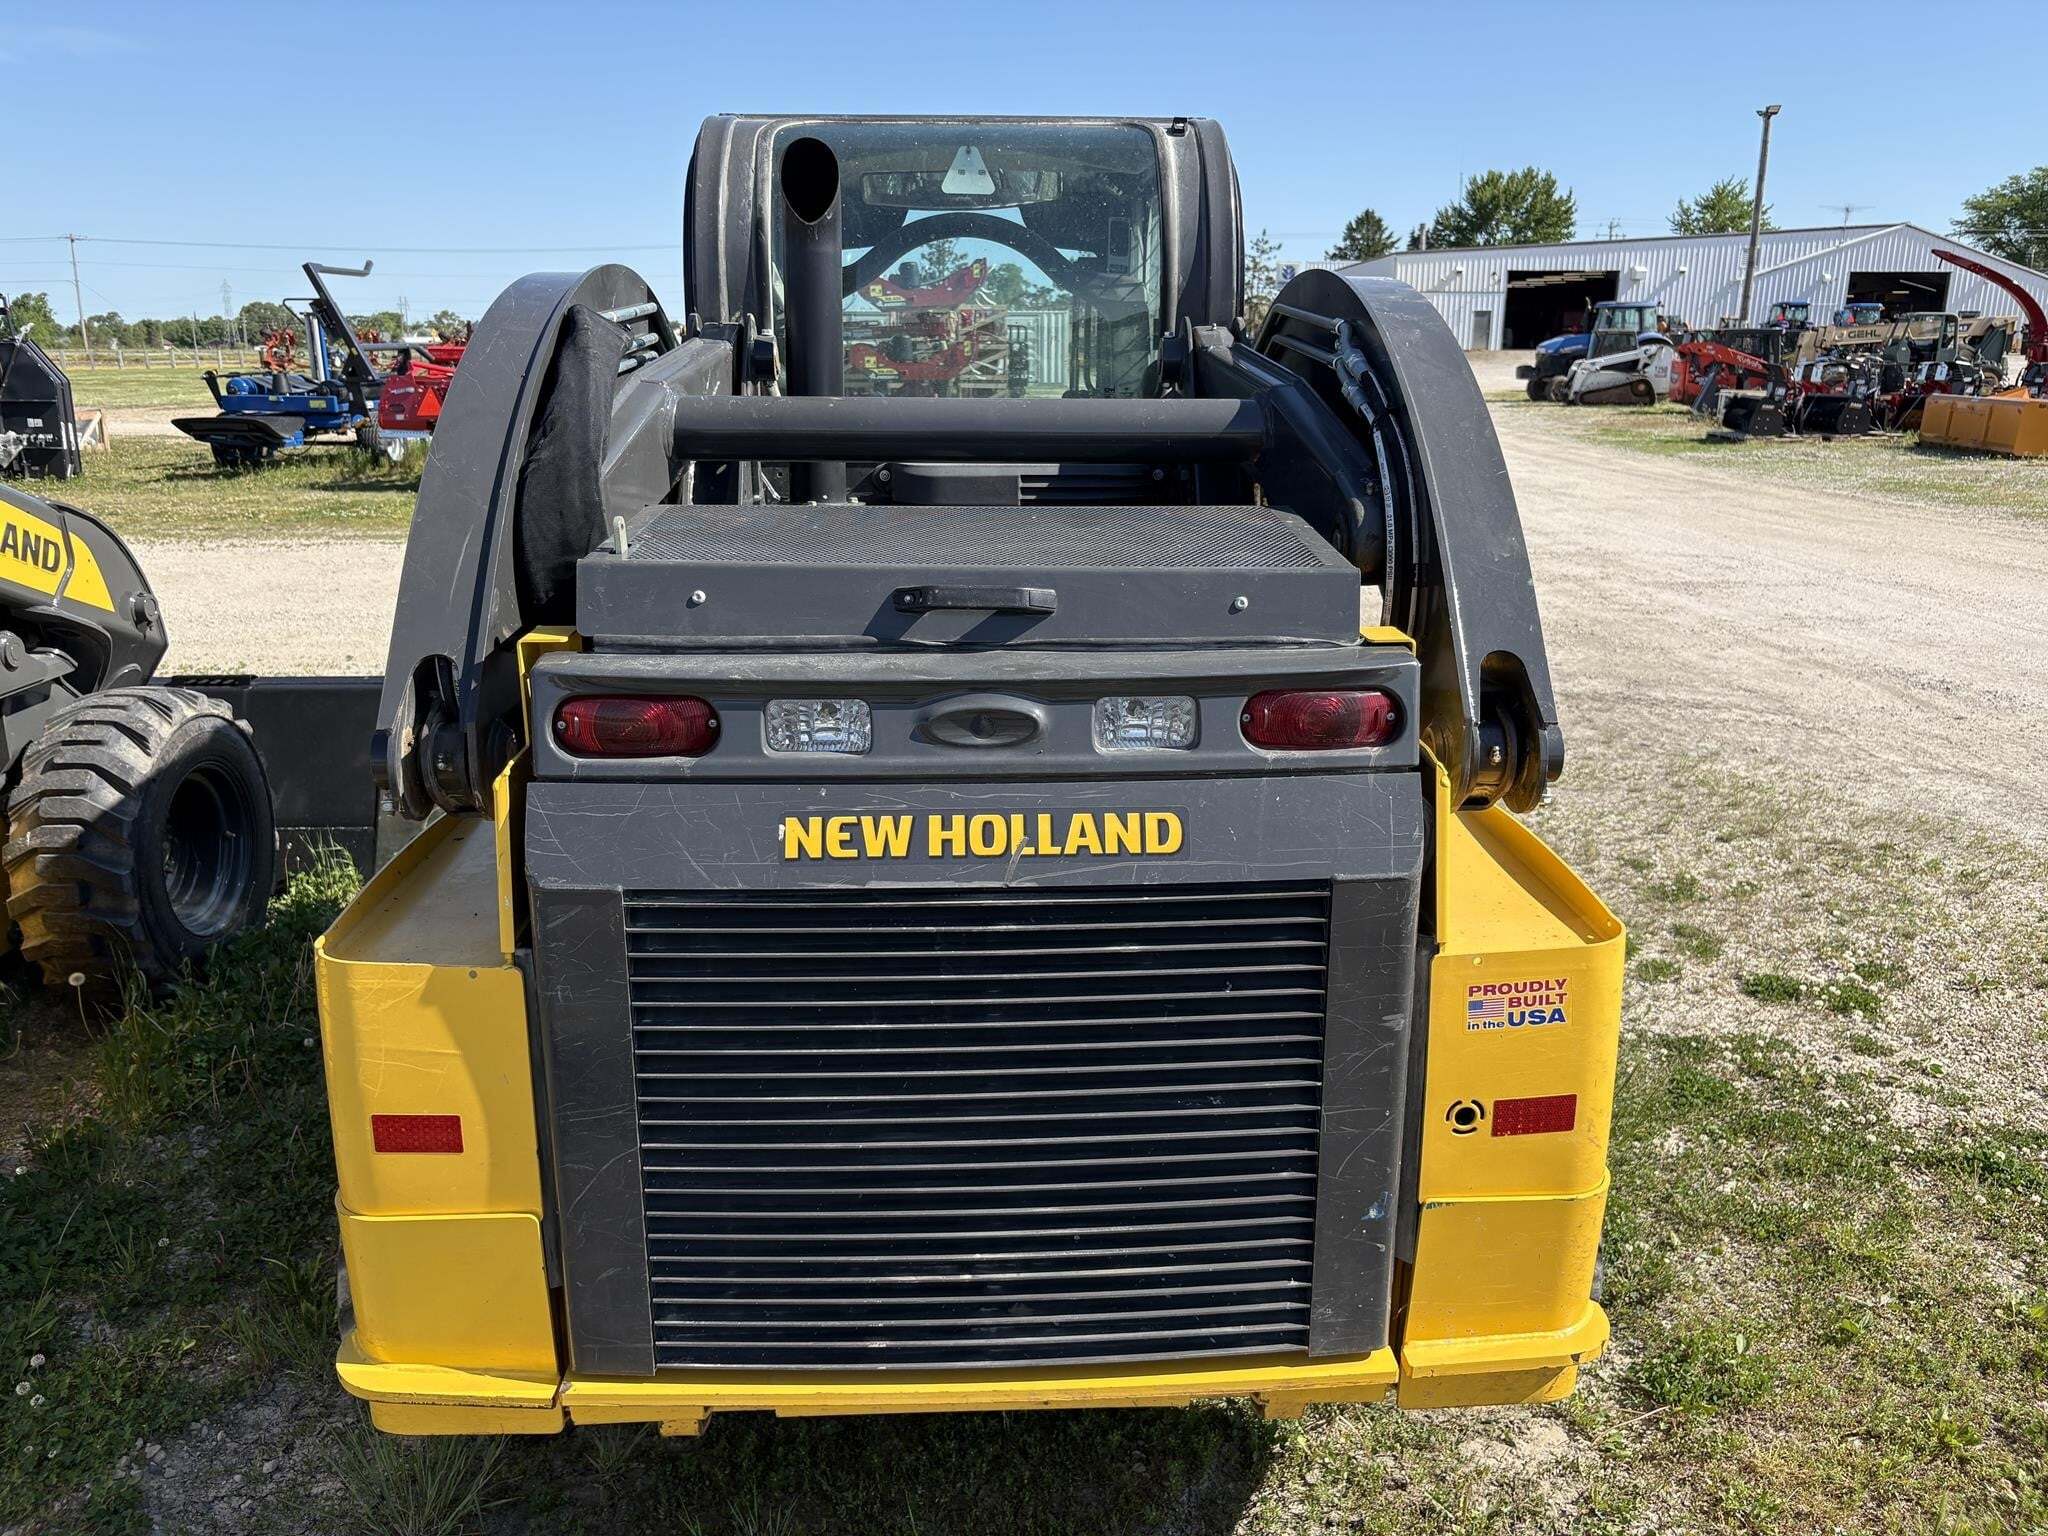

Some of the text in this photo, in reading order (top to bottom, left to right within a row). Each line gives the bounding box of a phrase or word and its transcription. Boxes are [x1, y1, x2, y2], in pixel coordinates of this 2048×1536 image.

[1848, 329, 1881, 339] GEHL
[0, 522, 61, 573] AND
[784, 812, 1184, 859] NEW HOLLAND
[1468, 978, 1568, 998] PROUDLY
[1508, 992, 1568, 1009] BUILT
[1467, 1007, 1566, 1030] in the USA
